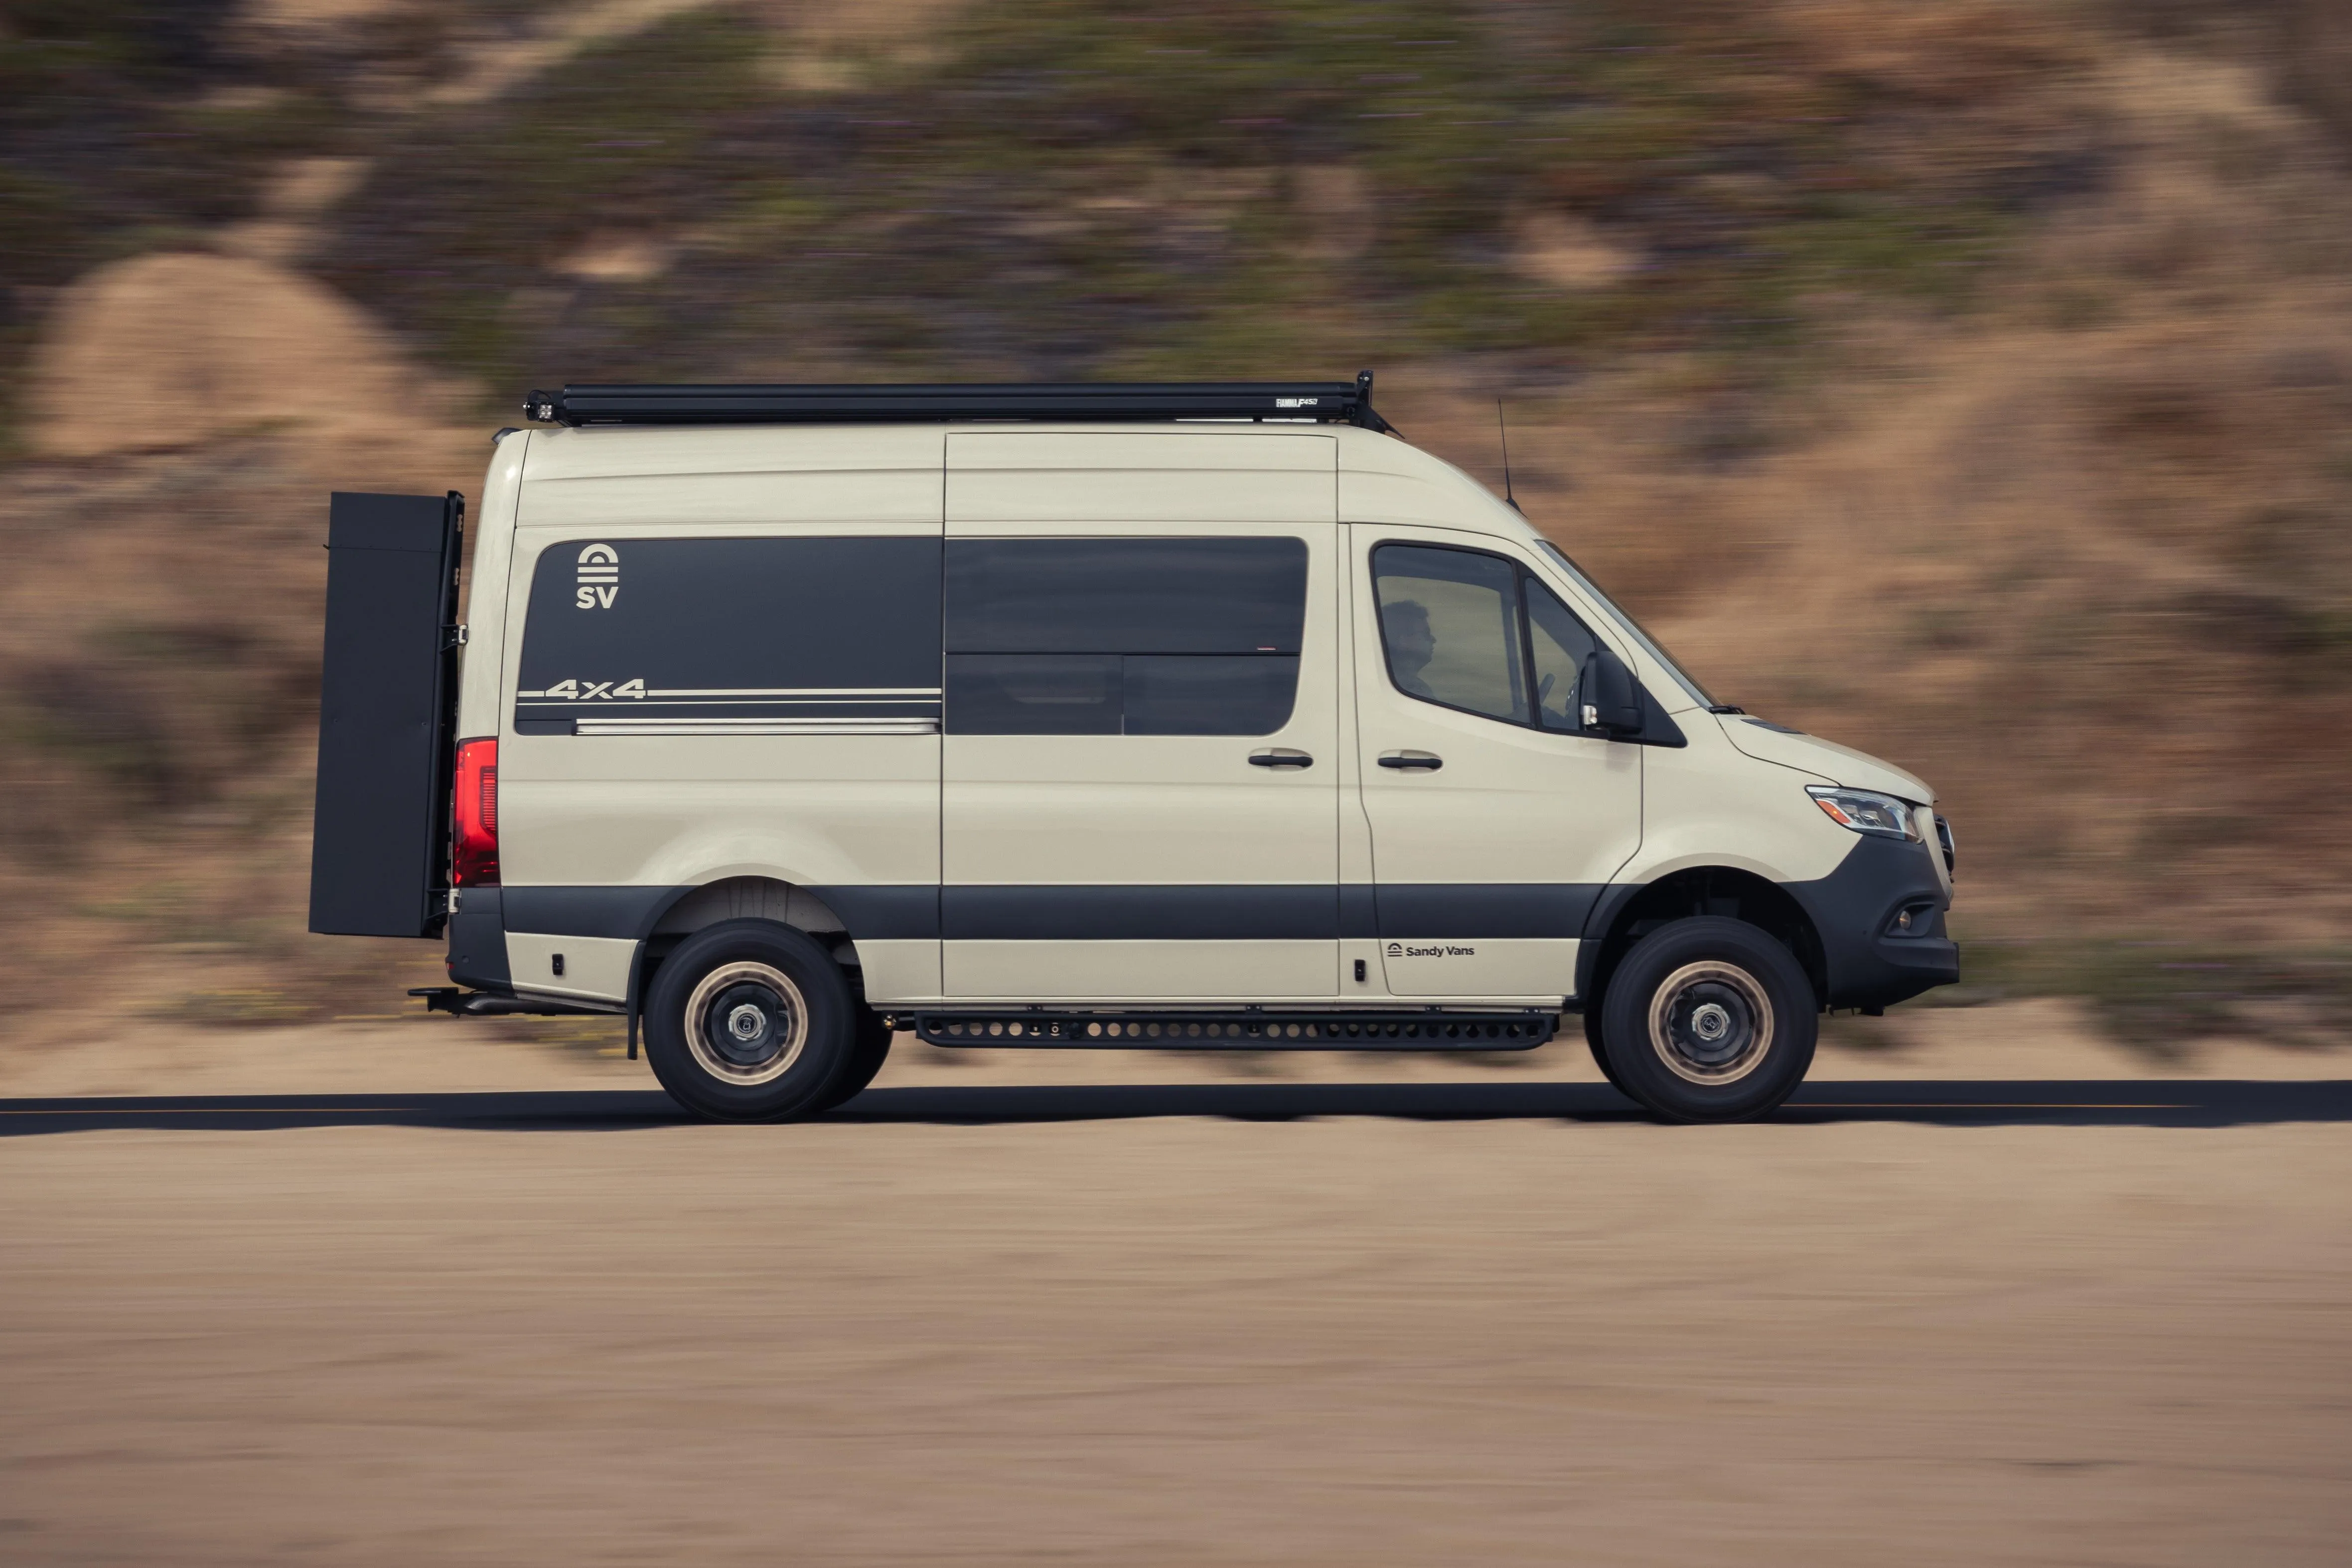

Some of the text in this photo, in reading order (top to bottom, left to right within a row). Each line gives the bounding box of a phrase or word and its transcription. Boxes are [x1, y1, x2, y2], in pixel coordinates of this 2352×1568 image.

[576, 586, 619, 609] SV
[1406, 946, 1474, 958] Sandy Vans
